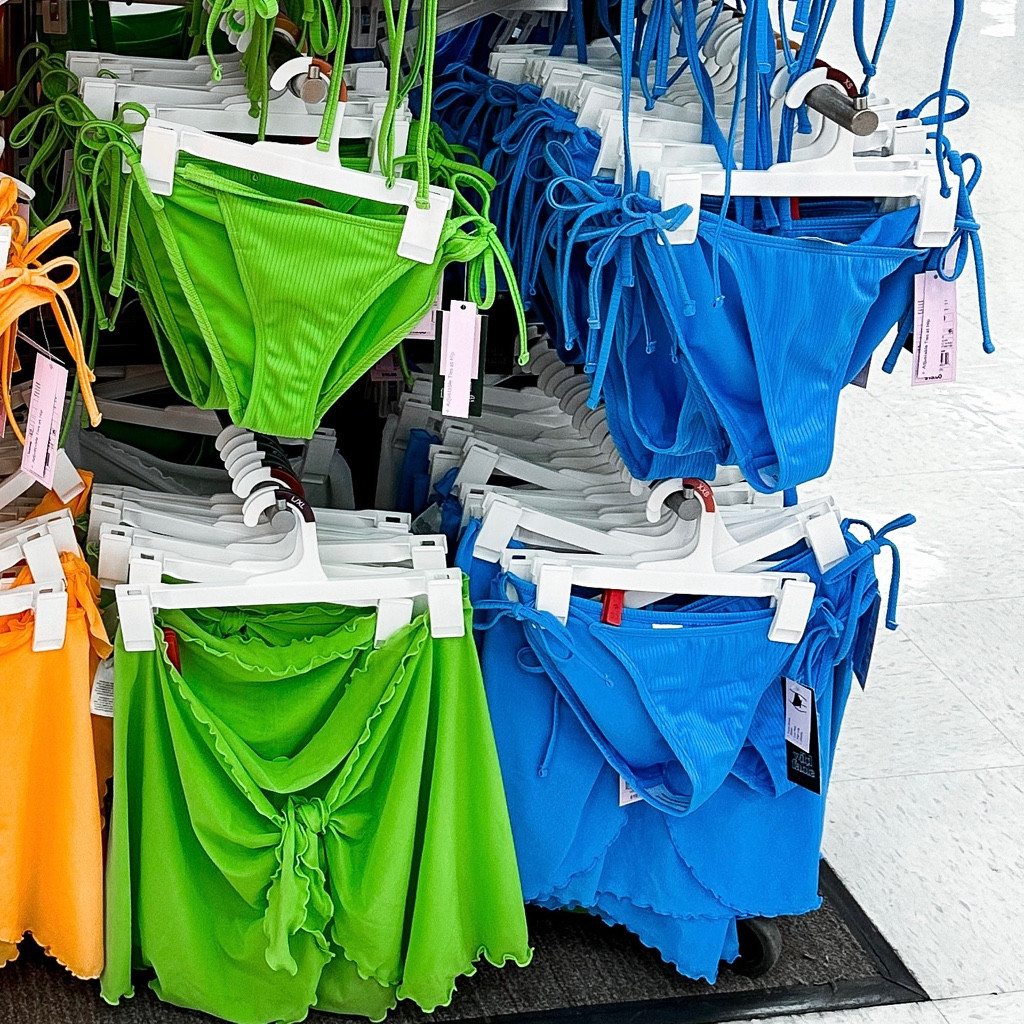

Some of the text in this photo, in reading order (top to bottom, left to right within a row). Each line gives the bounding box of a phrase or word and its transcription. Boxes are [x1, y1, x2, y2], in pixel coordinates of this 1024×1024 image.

[843, 78, 854, 90] XS
[697, 484, 709, 497] XXS
[291, 496, 305, 510] L/XL
